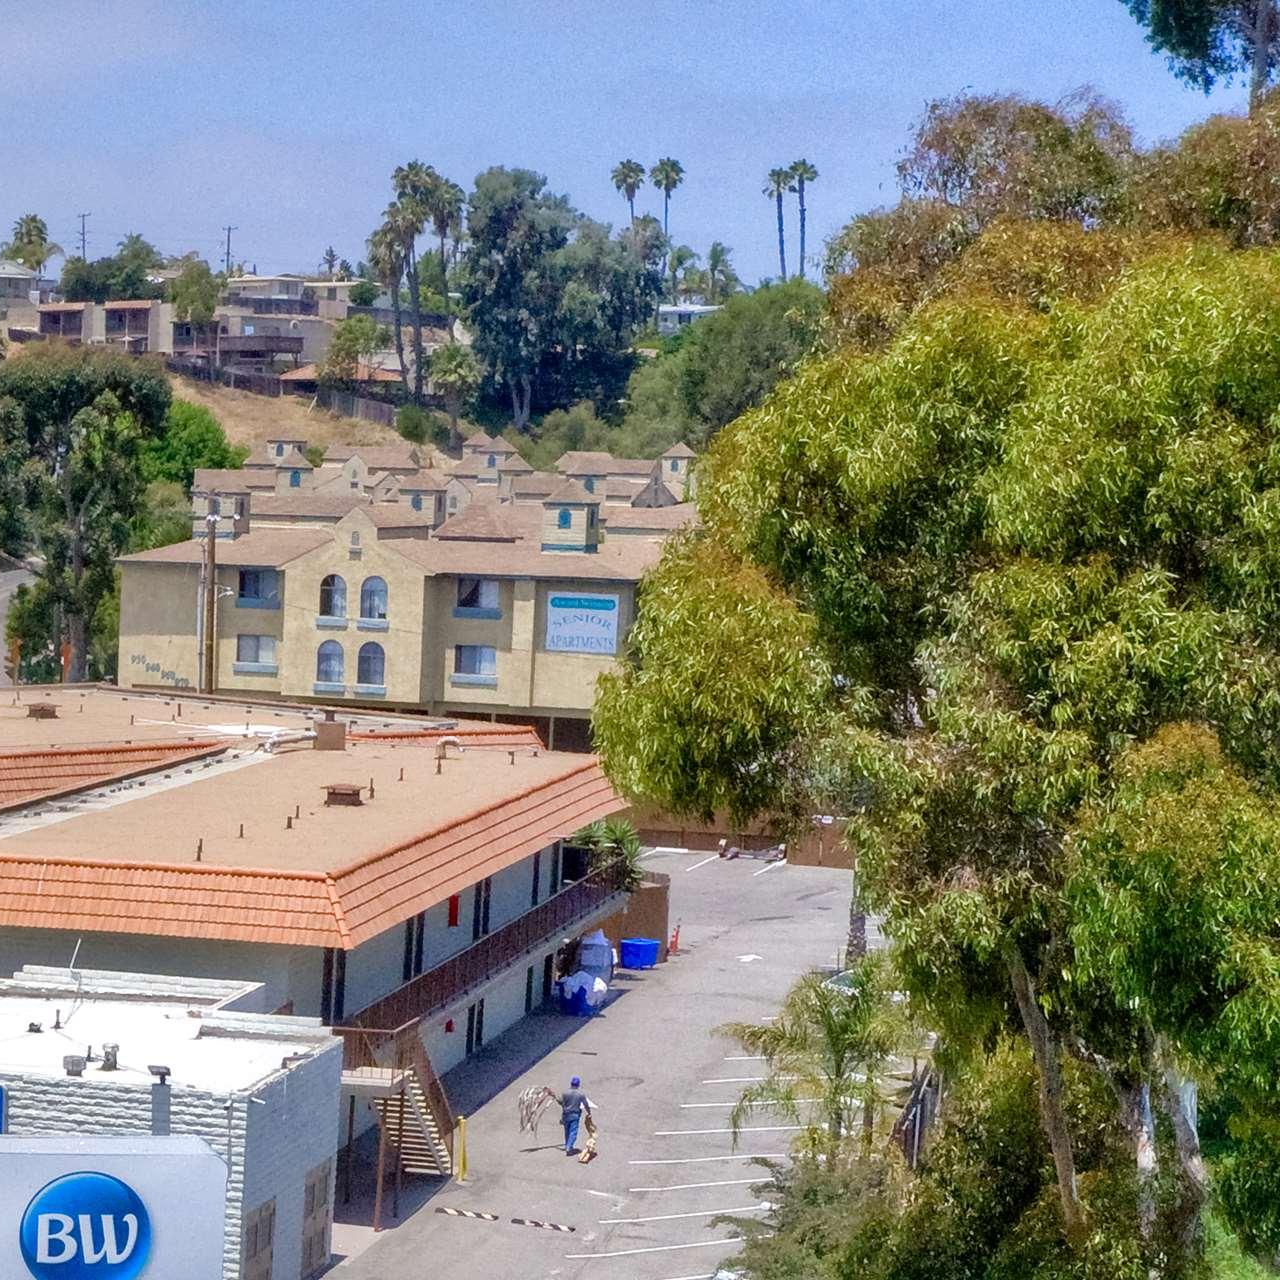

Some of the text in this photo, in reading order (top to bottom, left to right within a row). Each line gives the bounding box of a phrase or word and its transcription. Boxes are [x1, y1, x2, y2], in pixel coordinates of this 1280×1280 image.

[552, 614, 612, 630] SENIOR
[549, 634, 614, 650] APARTMENTS
[35, 1212, 139, 1266] BW
